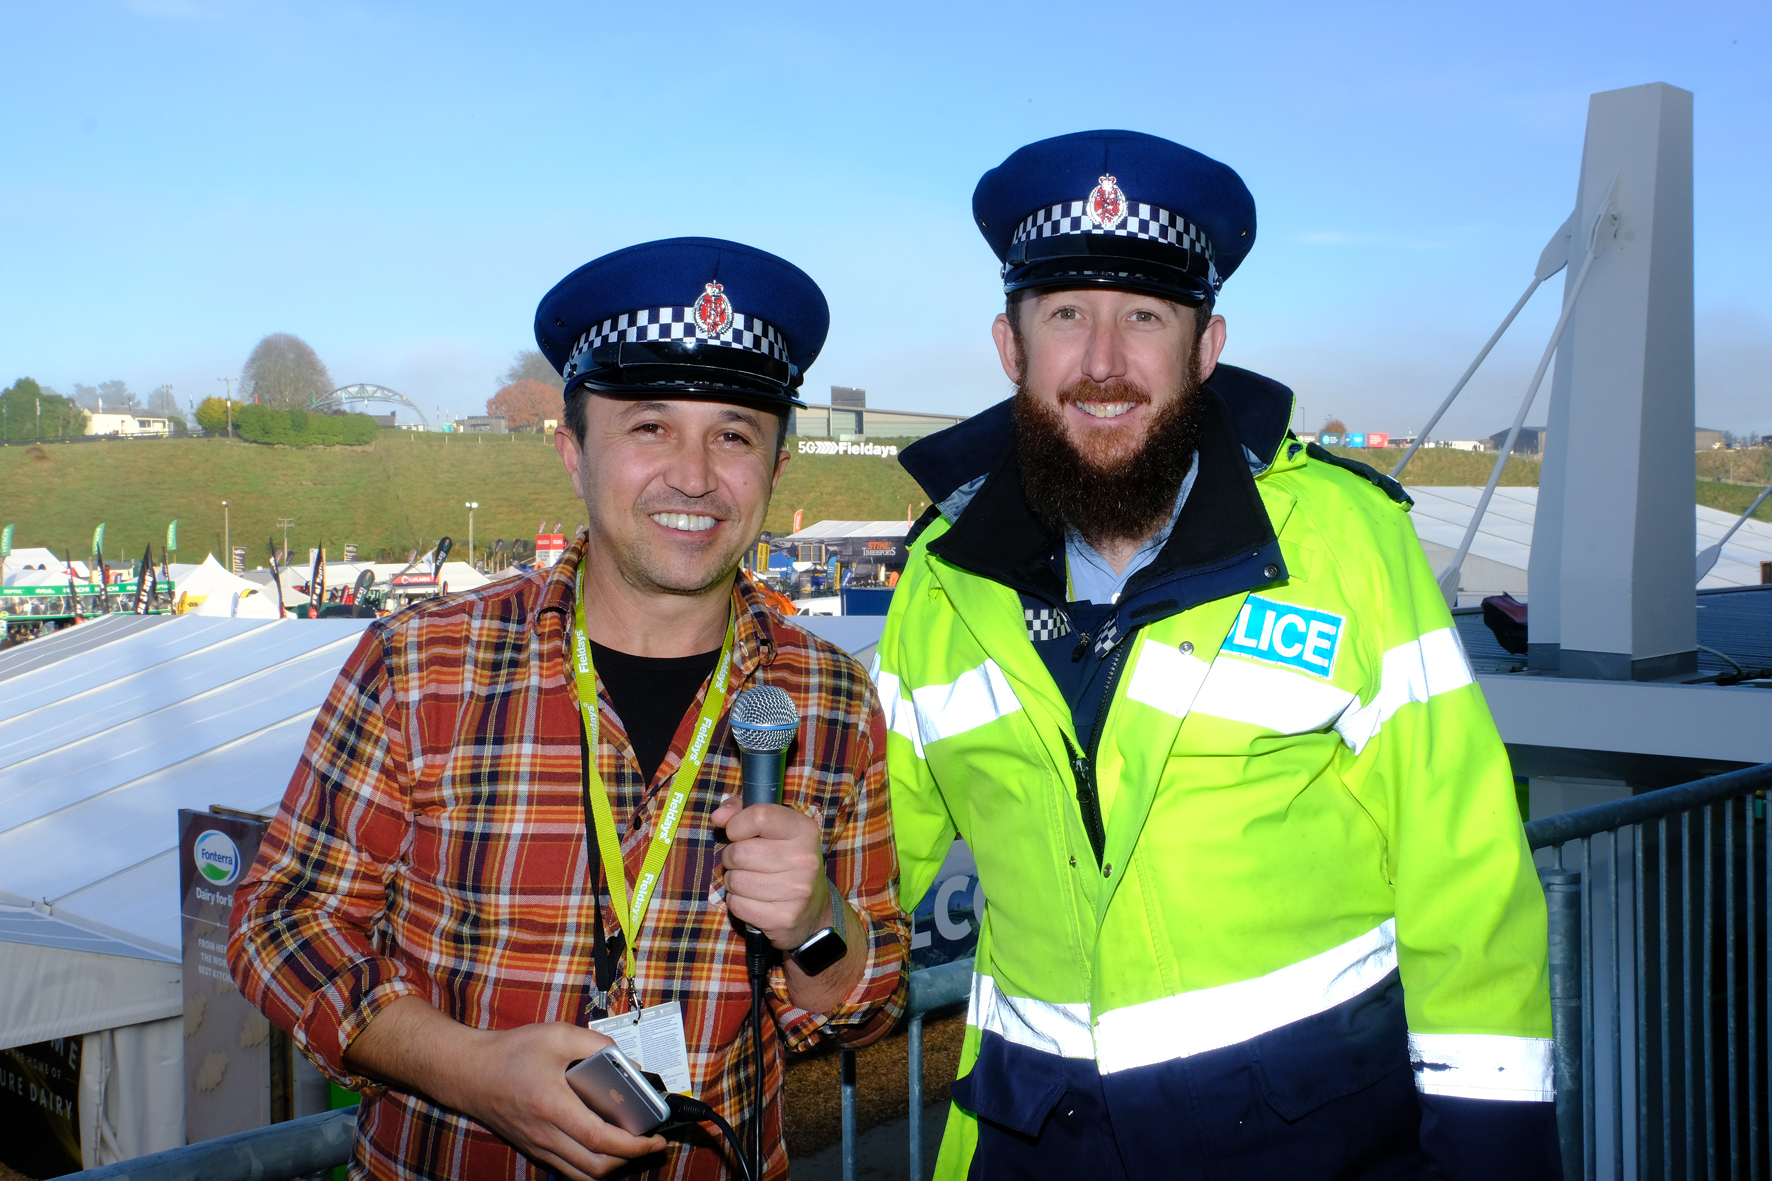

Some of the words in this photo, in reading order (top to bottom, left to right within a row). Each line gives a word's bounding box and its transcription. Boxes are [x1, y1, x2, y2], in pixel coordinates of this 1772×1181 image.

[839, 442, 898, 458] Fieldays
[868, 541, 891, 550] STIHL
[354, 586, 368, 605] FLEXI
[1227, 603, 1337, 667] LICE
[575, 629, 589, 674] Fieldays
[690, 717, 713, 763] Fieldays
[660, 792, 684, 842] Fieldays
[201, 848, 233, 866] Fonterra
[196, 887, 216, 905] Dairy
[216, 891, 228, 905] for
[632, 873, 654, 924] Fieldays
[199, 938, 215, 951] FROM
[201, 952, 212, 964] THE
[199, 965, 211, 978] BEST
[28, 1056, 49, 1075] HOME
[51, 1067, 62, 1080] OF
[30, 1082, 73, 1120] DAIRY
